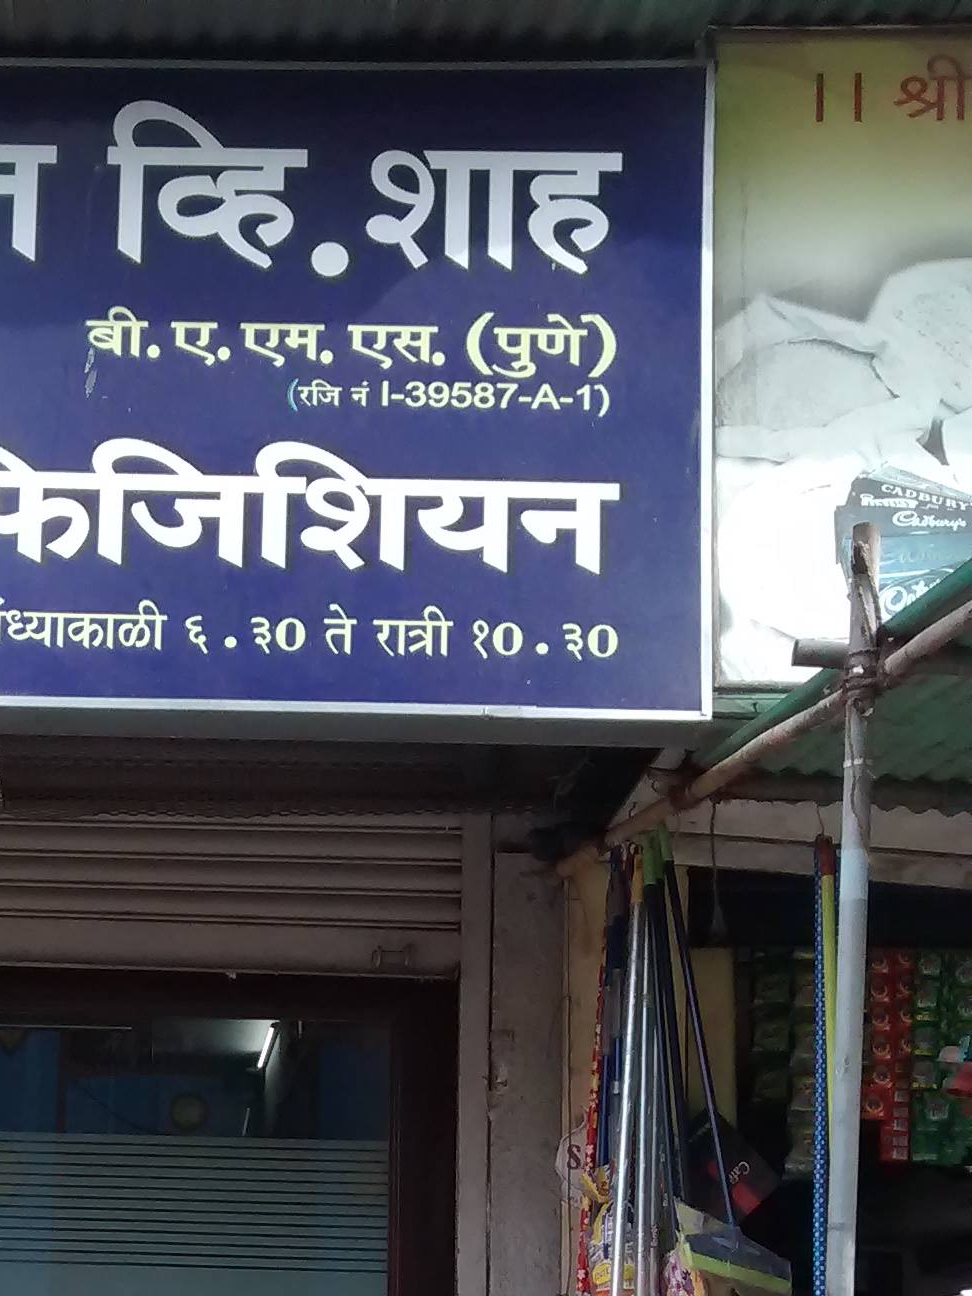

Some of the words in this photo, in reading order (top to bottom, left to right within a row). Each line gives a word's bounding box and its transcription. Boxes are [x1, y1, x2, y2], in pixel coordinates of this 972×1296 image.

[366, 151, 622, 274] शाह
[86, 307, 160, 358] बी.
[171, 322, 230, 366] ए.
[241, 323, 333, 367] एम.
[348, 325, 445, 369] एस.
[467, 313, 616, 378] (पुणे)
[324, 604, 357, 654] ते
[373, 606, 453, 656] रात्री
